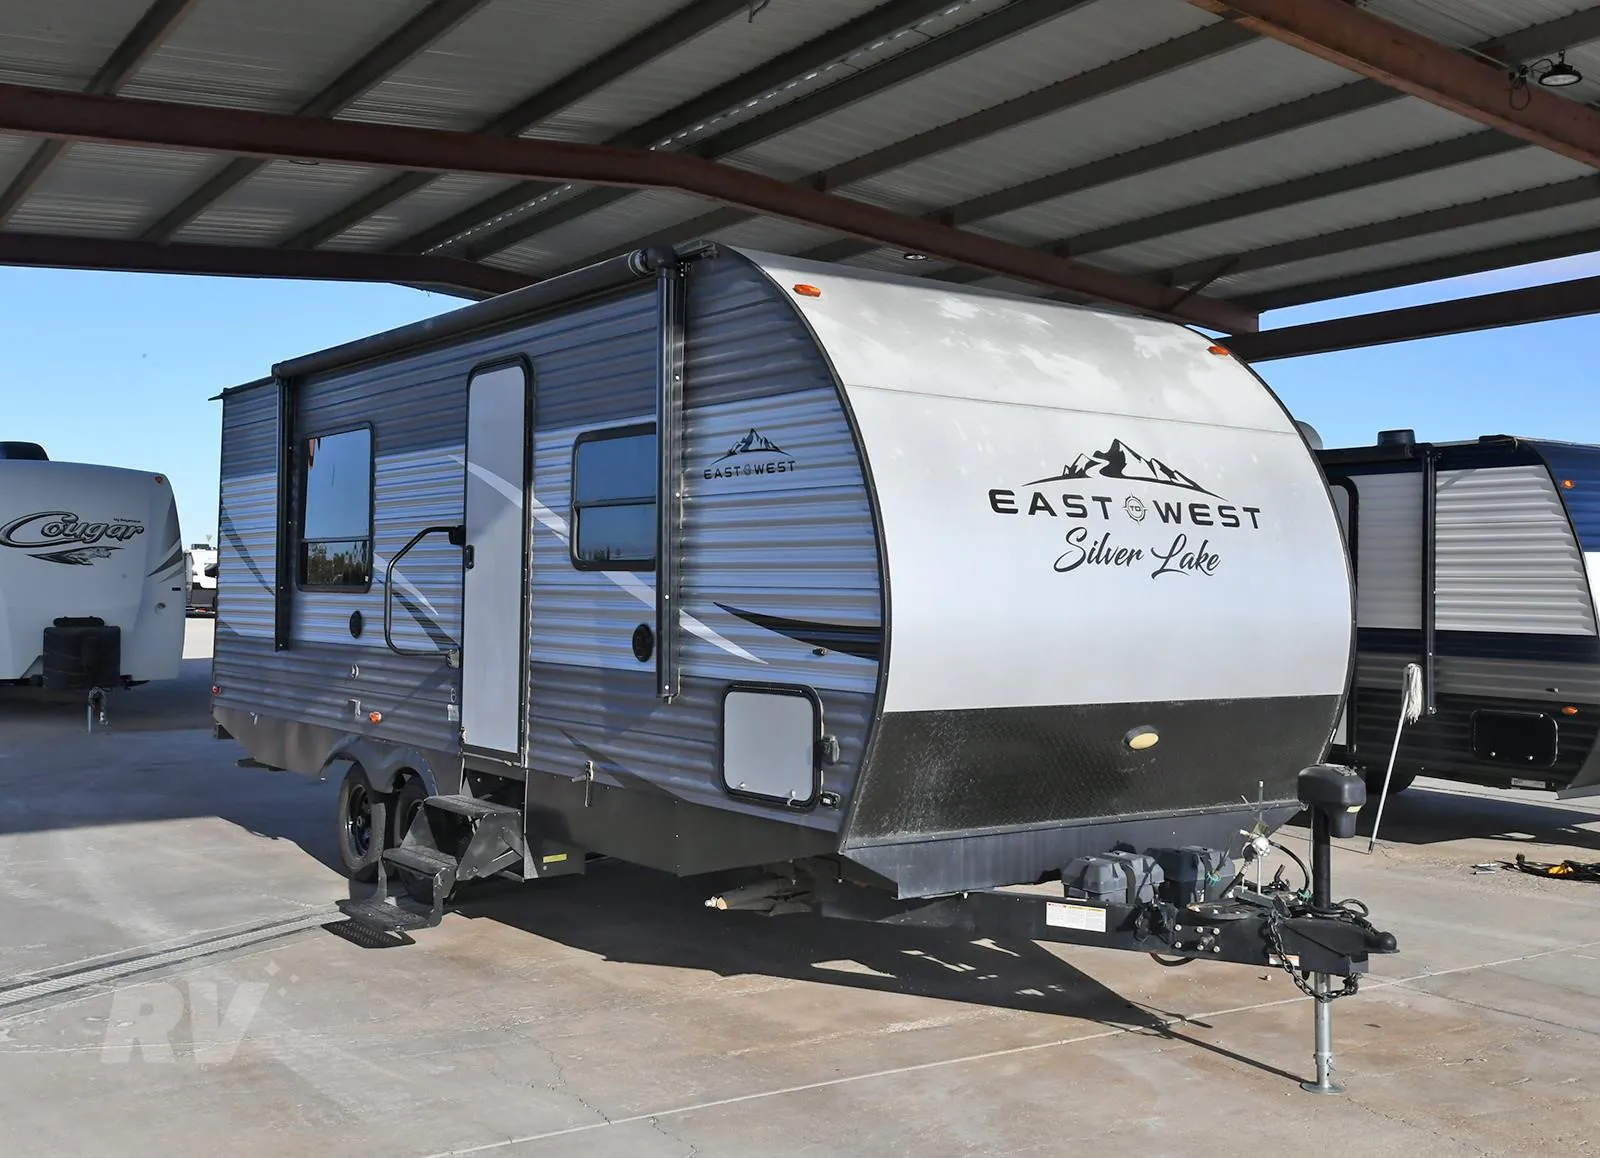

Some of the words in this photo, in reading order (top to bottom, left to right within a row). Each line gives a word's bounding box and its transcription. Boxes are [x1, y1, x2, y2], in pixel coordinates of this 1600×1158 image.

[704, 466, 740, 479] EAST
[754, 461, 796, 475] WEST
[988, 488, 1112, 520] EAST
[1152, 500, 1261, 529] WEST
[0, 511, 144, 548] Cougar
[1053, 527, 1144, 573] Silver
[1151, 533, 1221, 580] Lake
